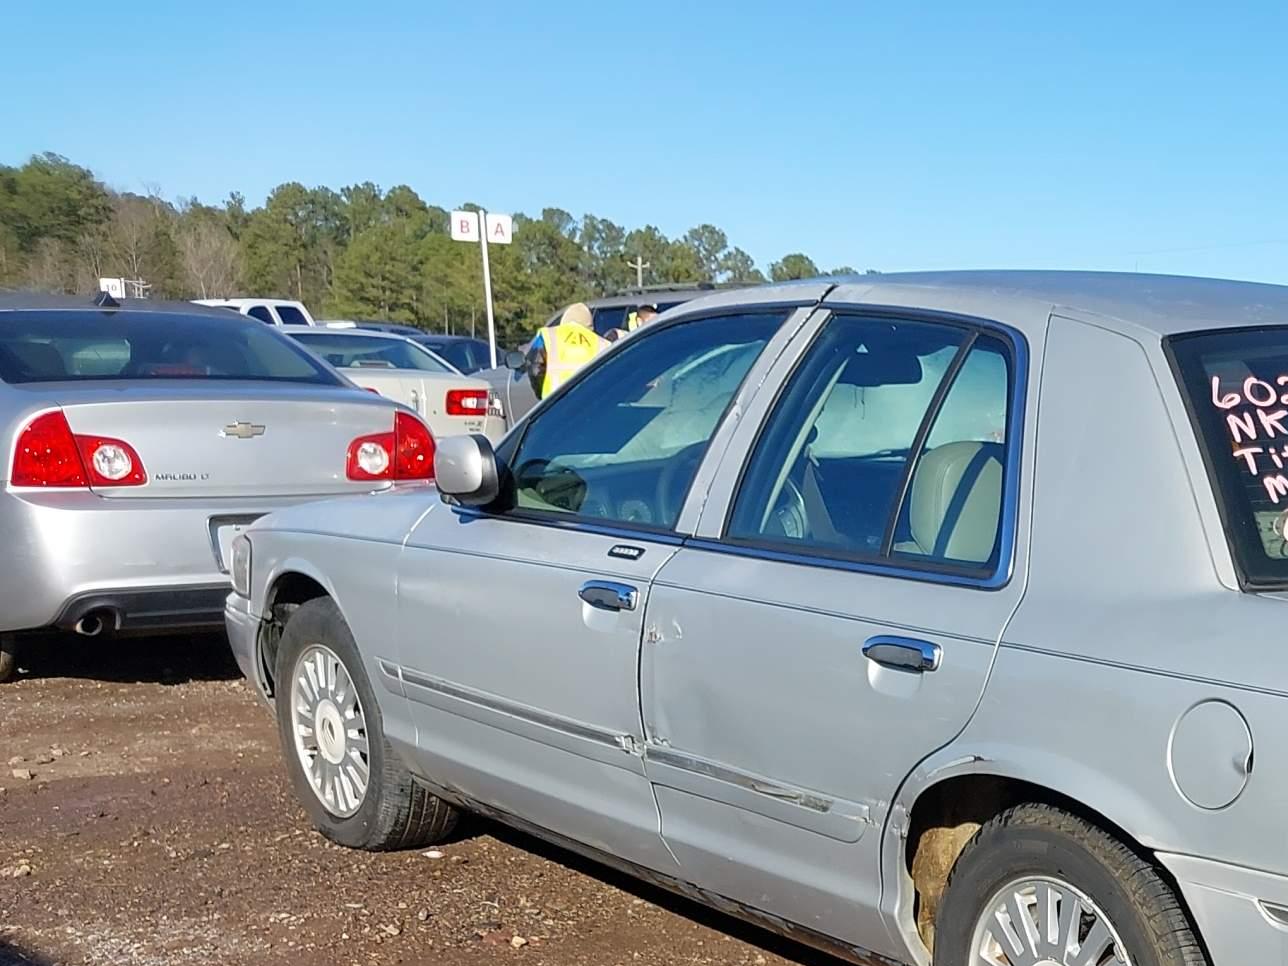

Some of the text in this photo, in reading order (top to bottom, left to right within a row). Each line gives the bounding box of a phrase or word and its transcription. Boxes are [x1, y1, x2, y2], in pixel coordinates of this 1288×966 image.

[460, 219, 470, 234] B
[494, 222, 505, 237] A
[1226, 408, 1288, 443] NK
